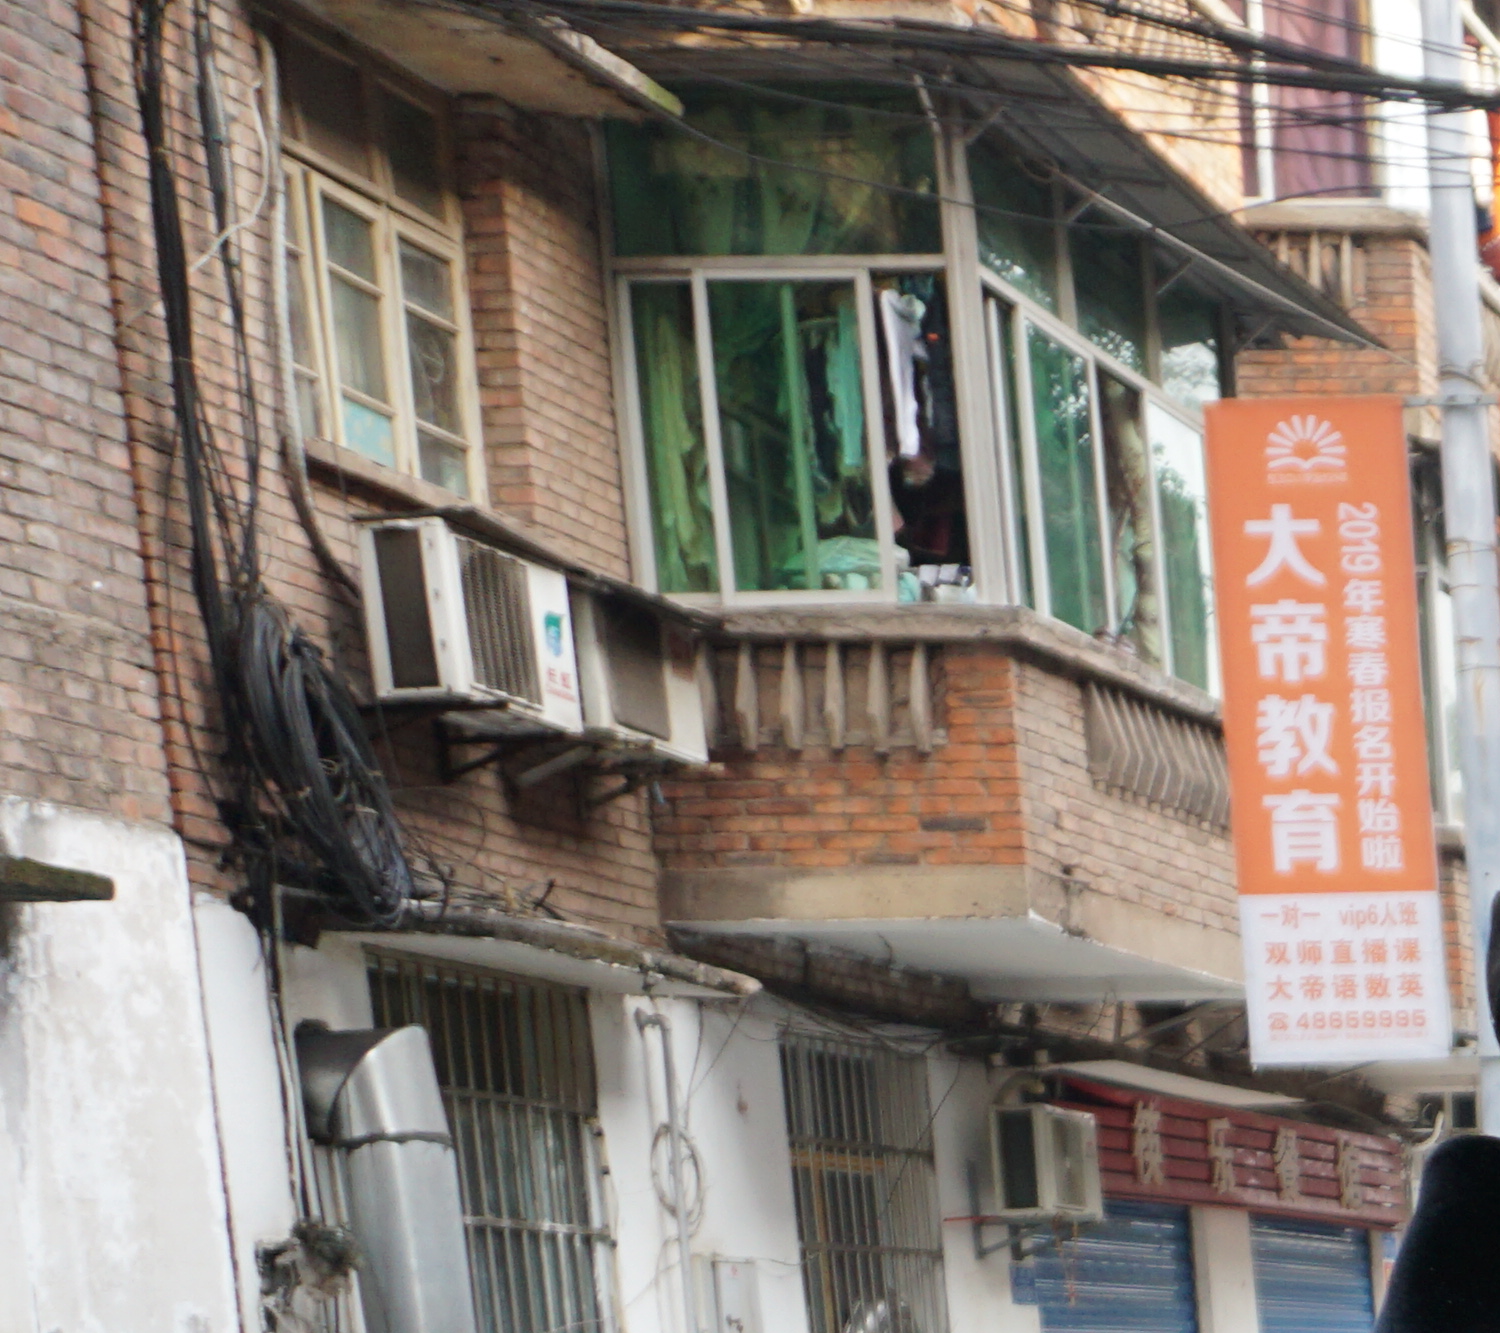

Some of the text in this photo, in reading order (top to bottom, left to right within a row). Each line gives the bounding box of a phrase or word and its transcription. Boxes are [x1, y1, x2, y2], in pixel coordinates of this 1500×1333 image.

[1243, 503, 1341, 873] 大帝教育
[1337, 502, 1404, 870] 2019年寒春报名开始啦
[1260, 901, 1419, 930] 一对一 vip6人班
[1264, 937, 1421, 965] 双师直播课
[1266, 973, 1424, 1000] 大帝语数英
